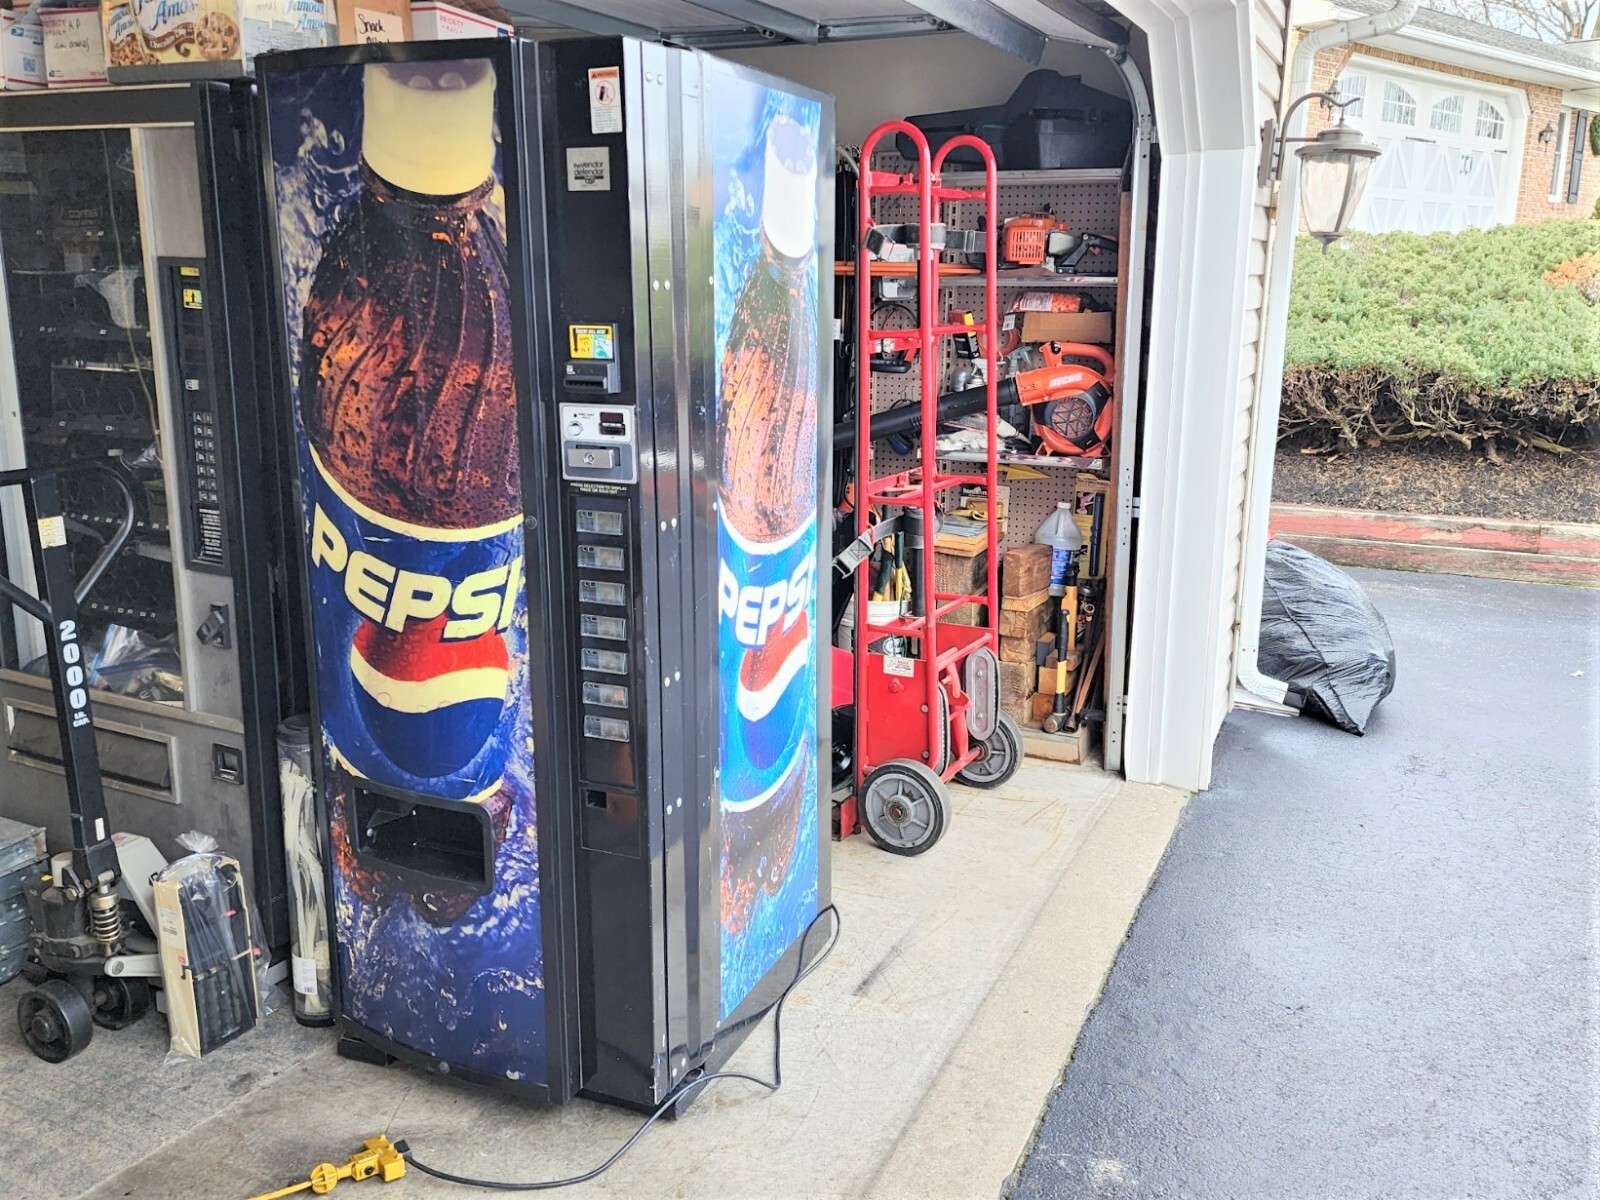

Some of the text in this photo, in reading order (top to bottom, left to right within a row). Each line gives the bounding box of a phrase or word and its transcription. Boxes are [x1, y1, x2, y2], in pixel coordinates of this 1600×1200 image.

[439, 15, 465, 28] PRIORITY
[311, 502, 524, 639] PEPSI
[718, 552, 815, 646] PEPSI
[59, 619, 87, 710] 2000
